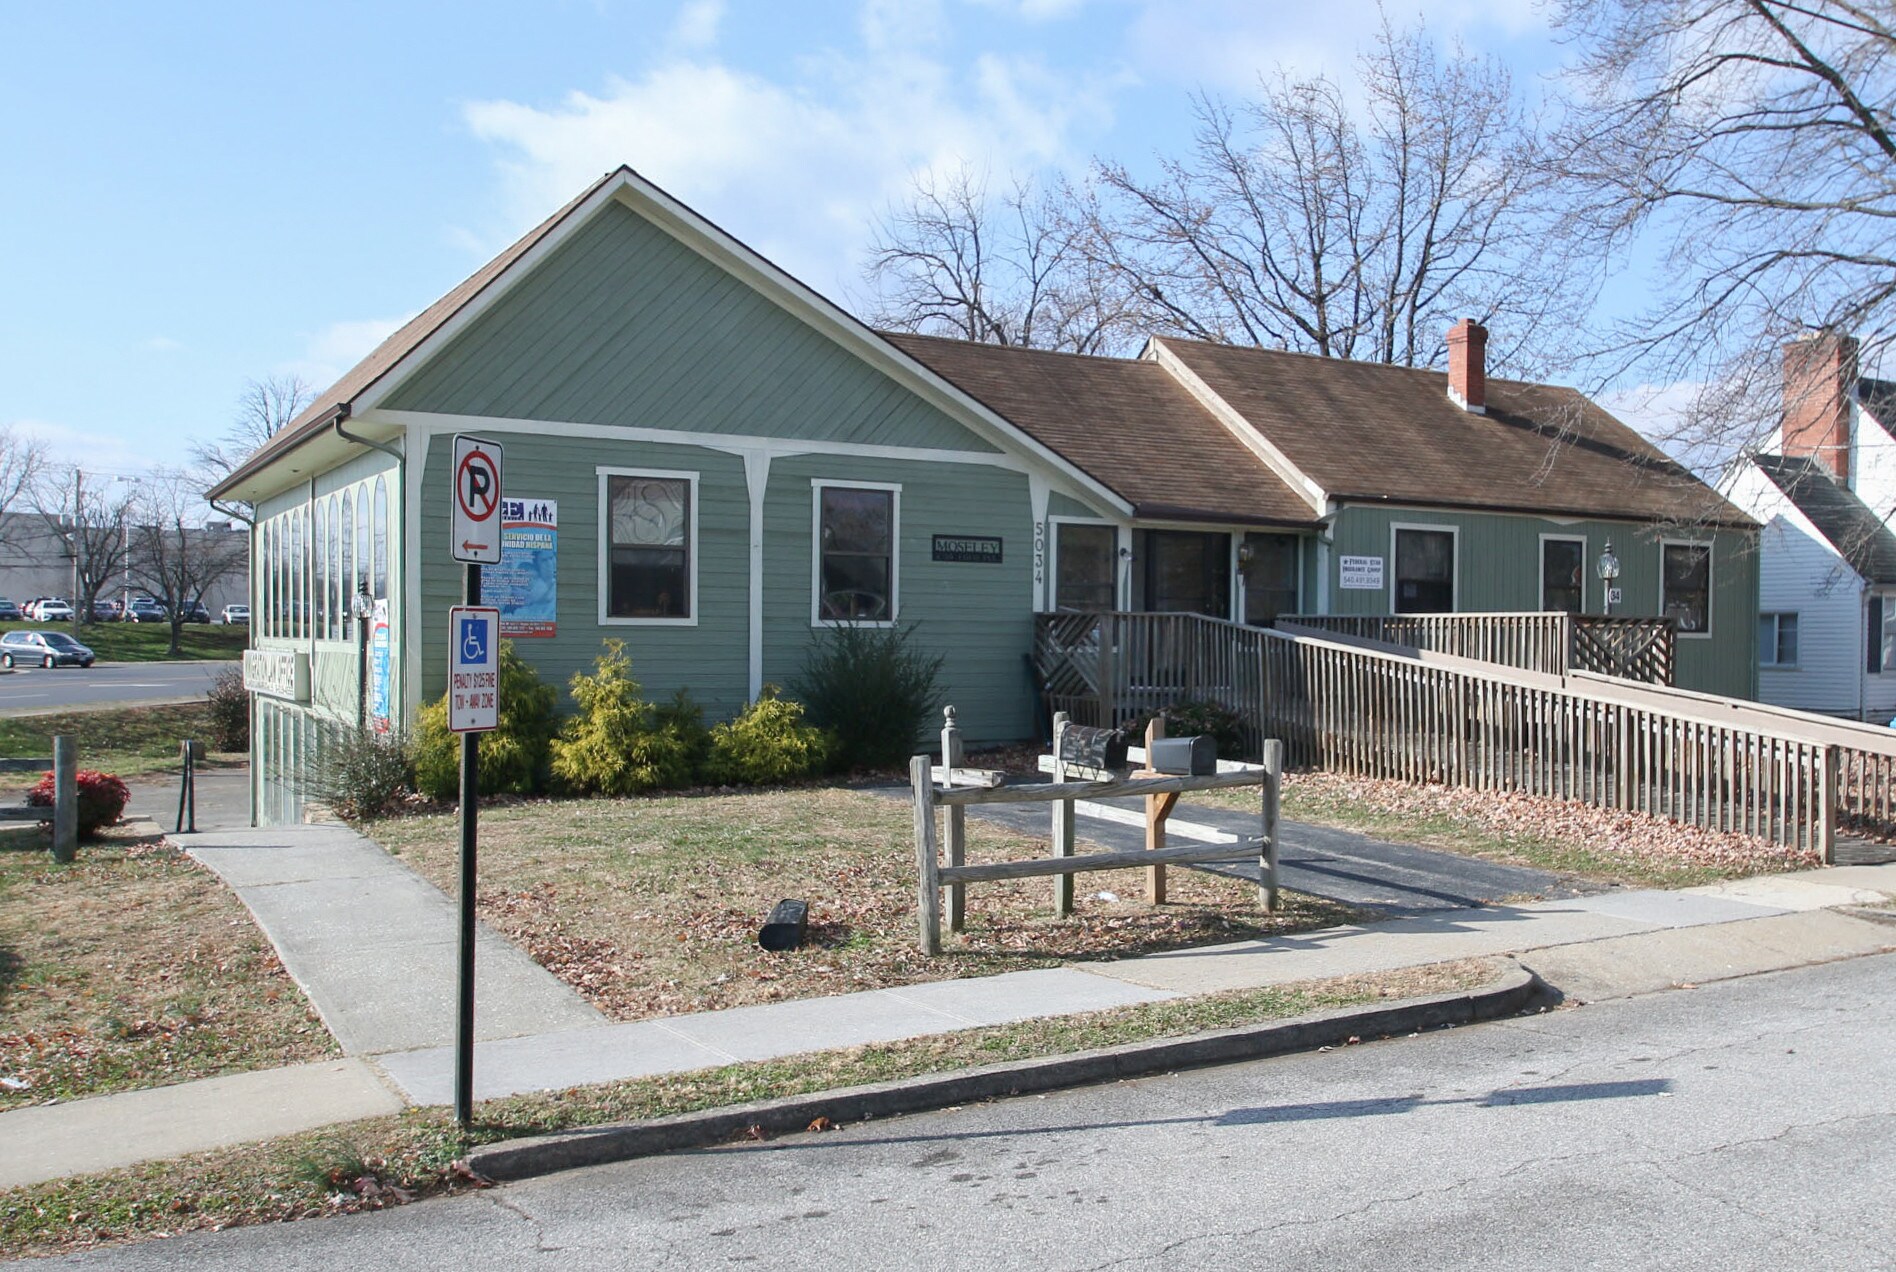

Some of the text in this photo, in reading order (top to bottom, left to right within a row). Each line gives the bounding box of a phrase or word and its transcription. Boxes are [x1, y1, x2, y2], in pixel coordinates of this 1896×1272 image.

[936, 540, 999, 554] MOSELEY
[1035, 522, 1044, 584] 5034
[454, 673, 472, 688] PENALTY
[485, 673, 495, 688] FINE
[455, 694, 465, 710] TOW
[469, 694, 481, 709] AWAY
[481, 693, 494, 708] ZONE
